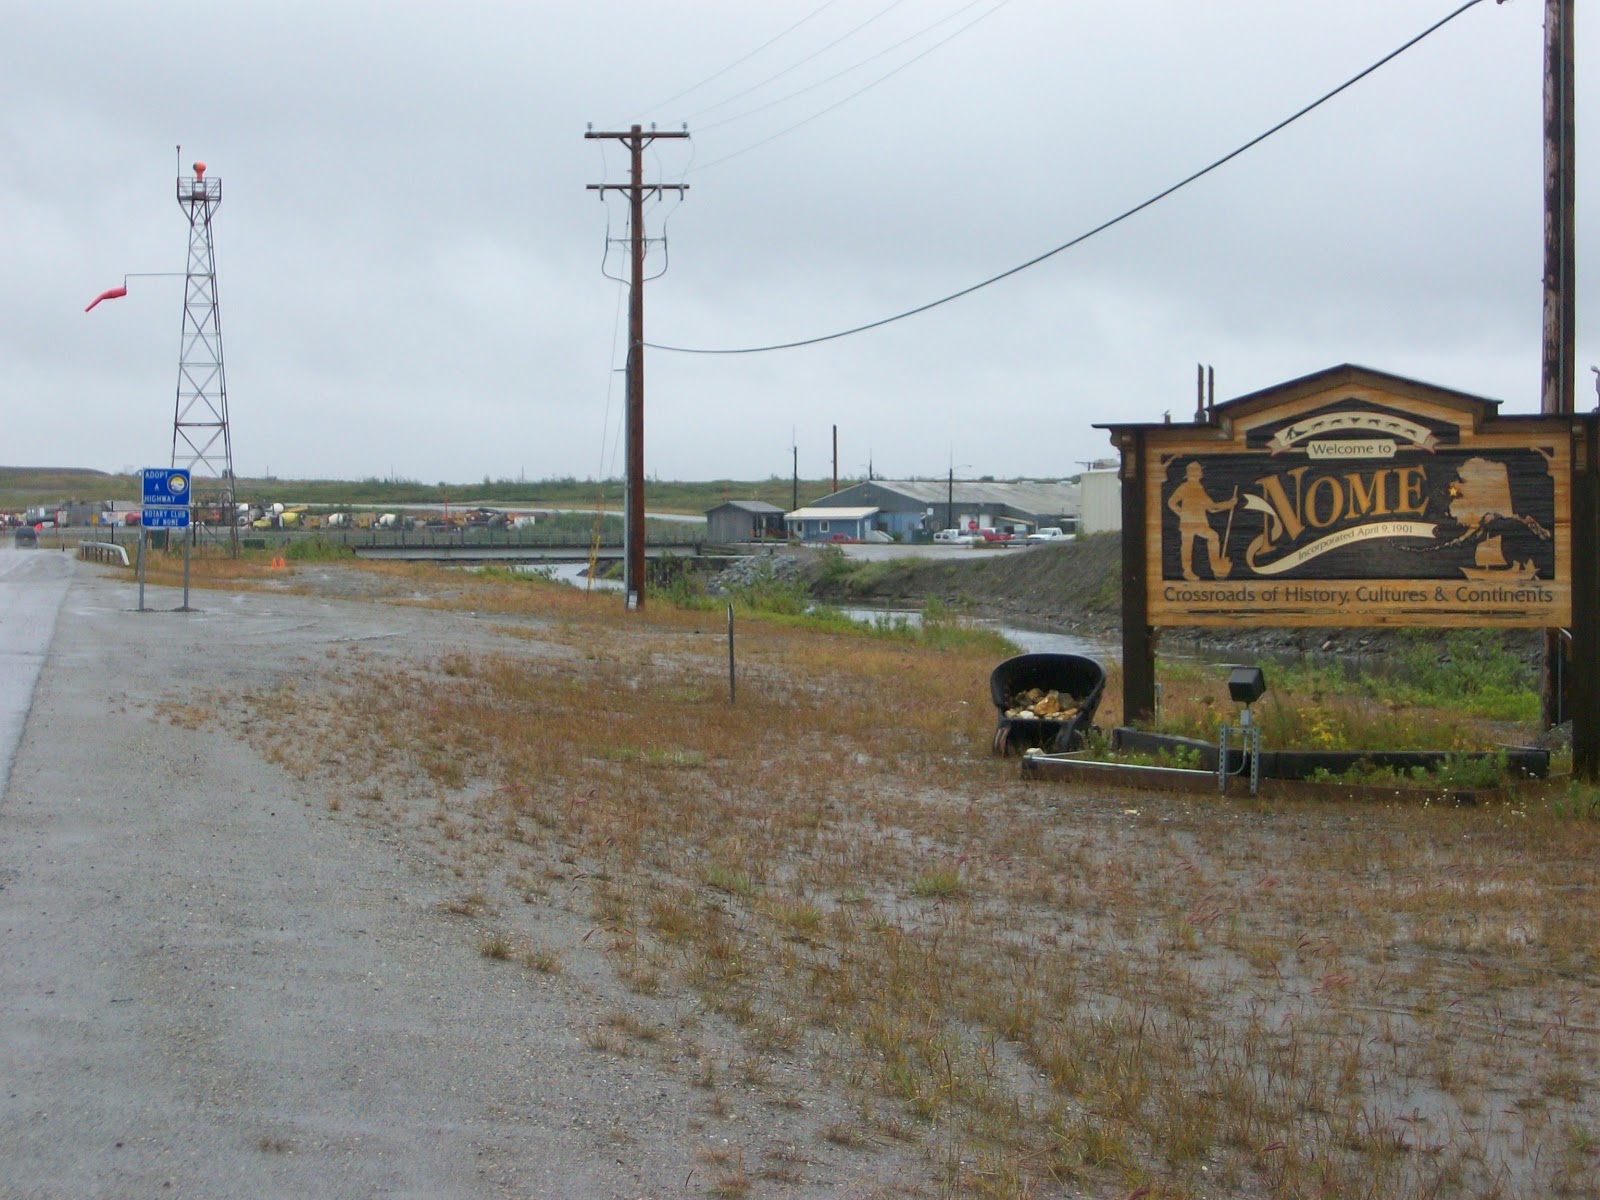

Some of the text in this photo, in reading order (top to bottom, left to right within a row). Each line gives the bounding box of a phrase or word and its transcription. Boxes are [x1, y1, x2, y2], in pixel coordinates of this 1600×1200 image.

[1312, 443, 1392, 455] Welcome to
[145, 471, 168, 479] ADOPT
[154, 483, 160, 491] A
[144, 495, 176, 503] HIGHWAY
[144, 510, 186, 518] ROTARY CLUB
[1255, 464, 1430, 556] NOME
[152, 518, 179, 526] OF NOME
[1298, 525, 1413, 561] Incorporated April 9, 1901
[1163, 585, 1554, 606] Crossroads of History, Cultures & Continents
